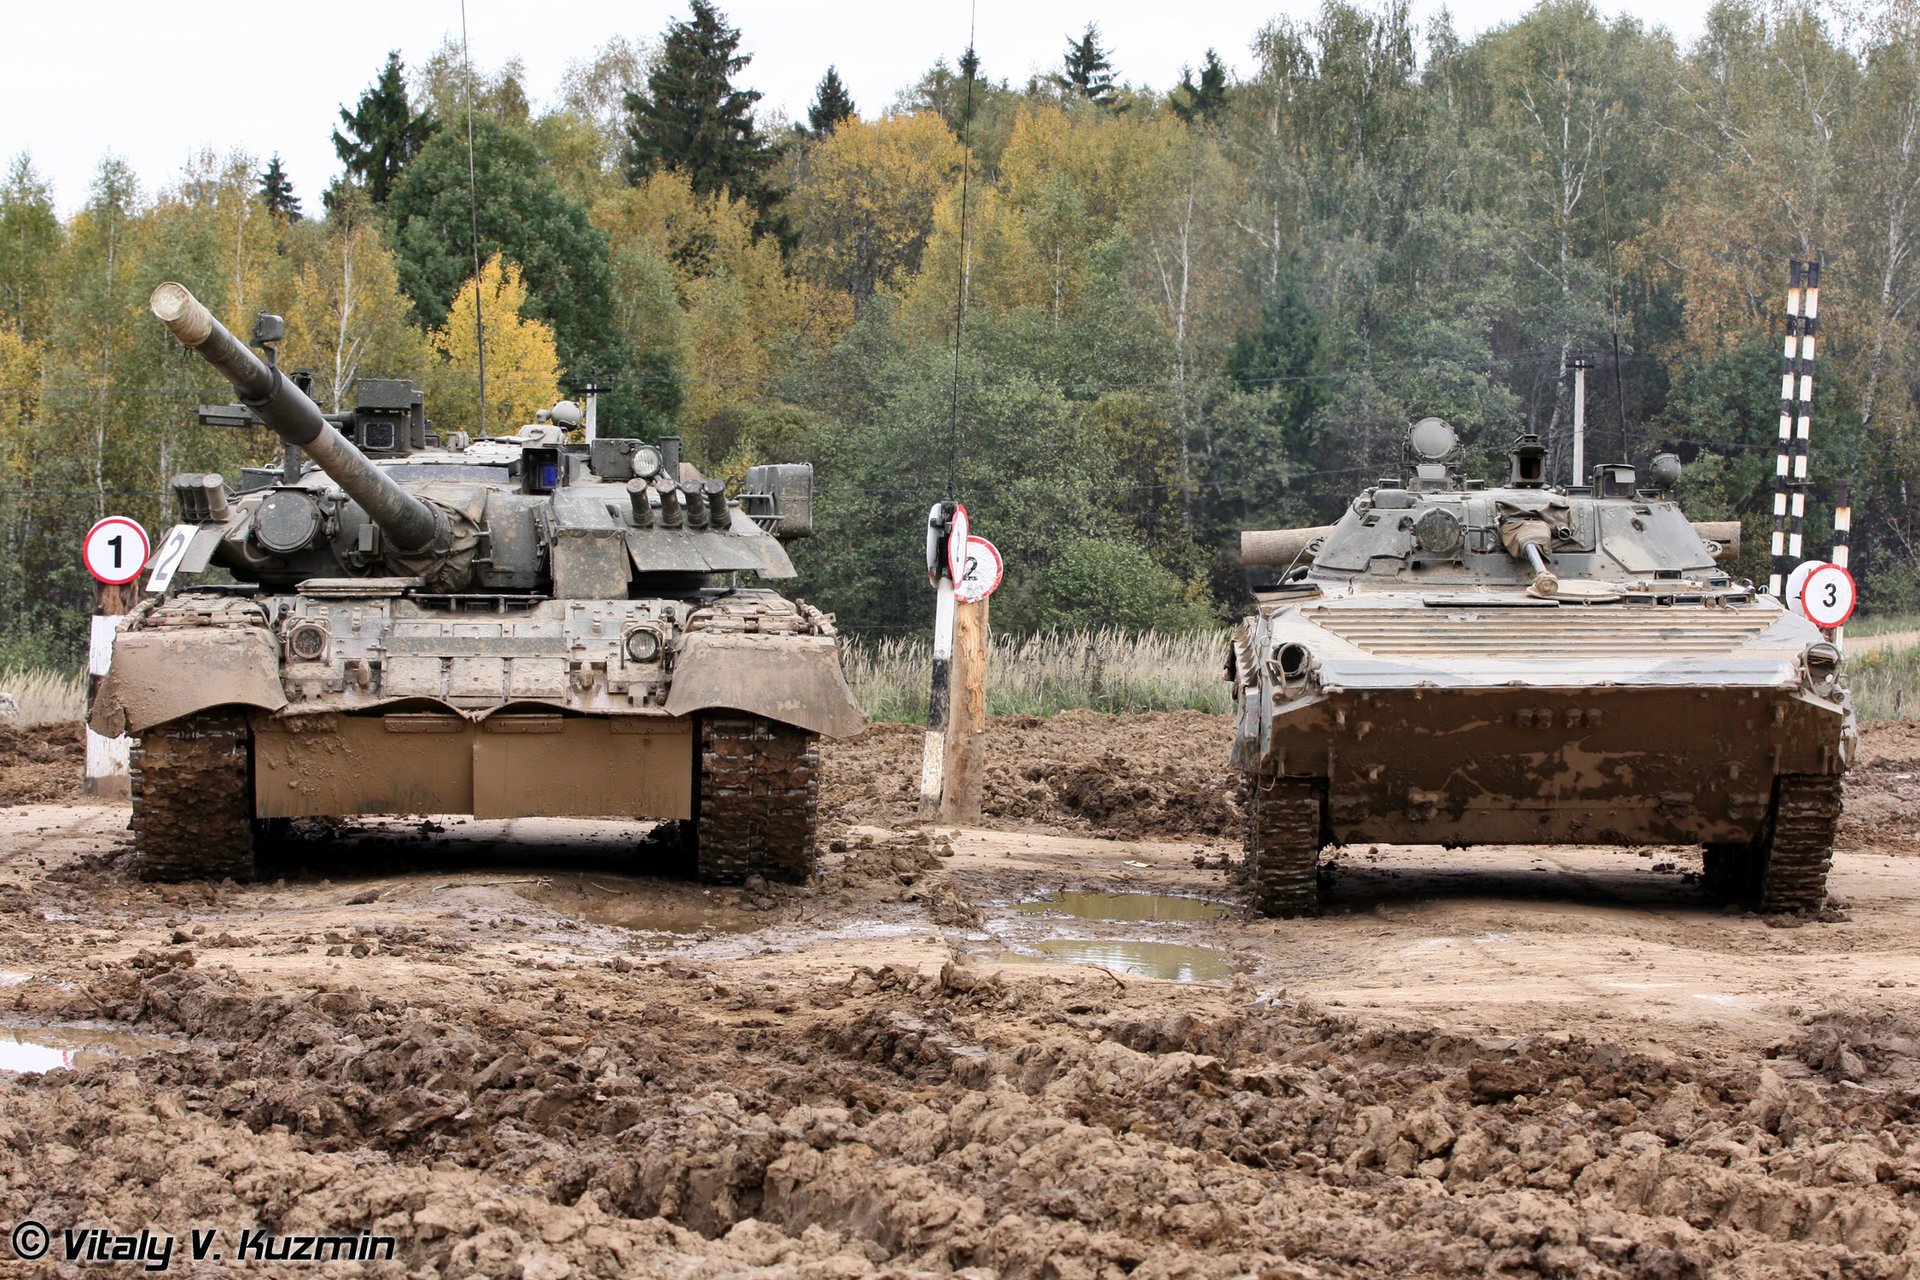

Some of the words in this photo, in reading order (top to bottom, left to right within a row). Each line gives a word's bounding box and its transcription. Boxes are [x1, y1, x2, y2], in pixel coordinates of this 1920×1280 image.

[107, 535, 122, 569] 1
[155, 530, 185, 581] 2
[963, 556, 978, 581] 2
[1822, 583, 1837, 608] 3
